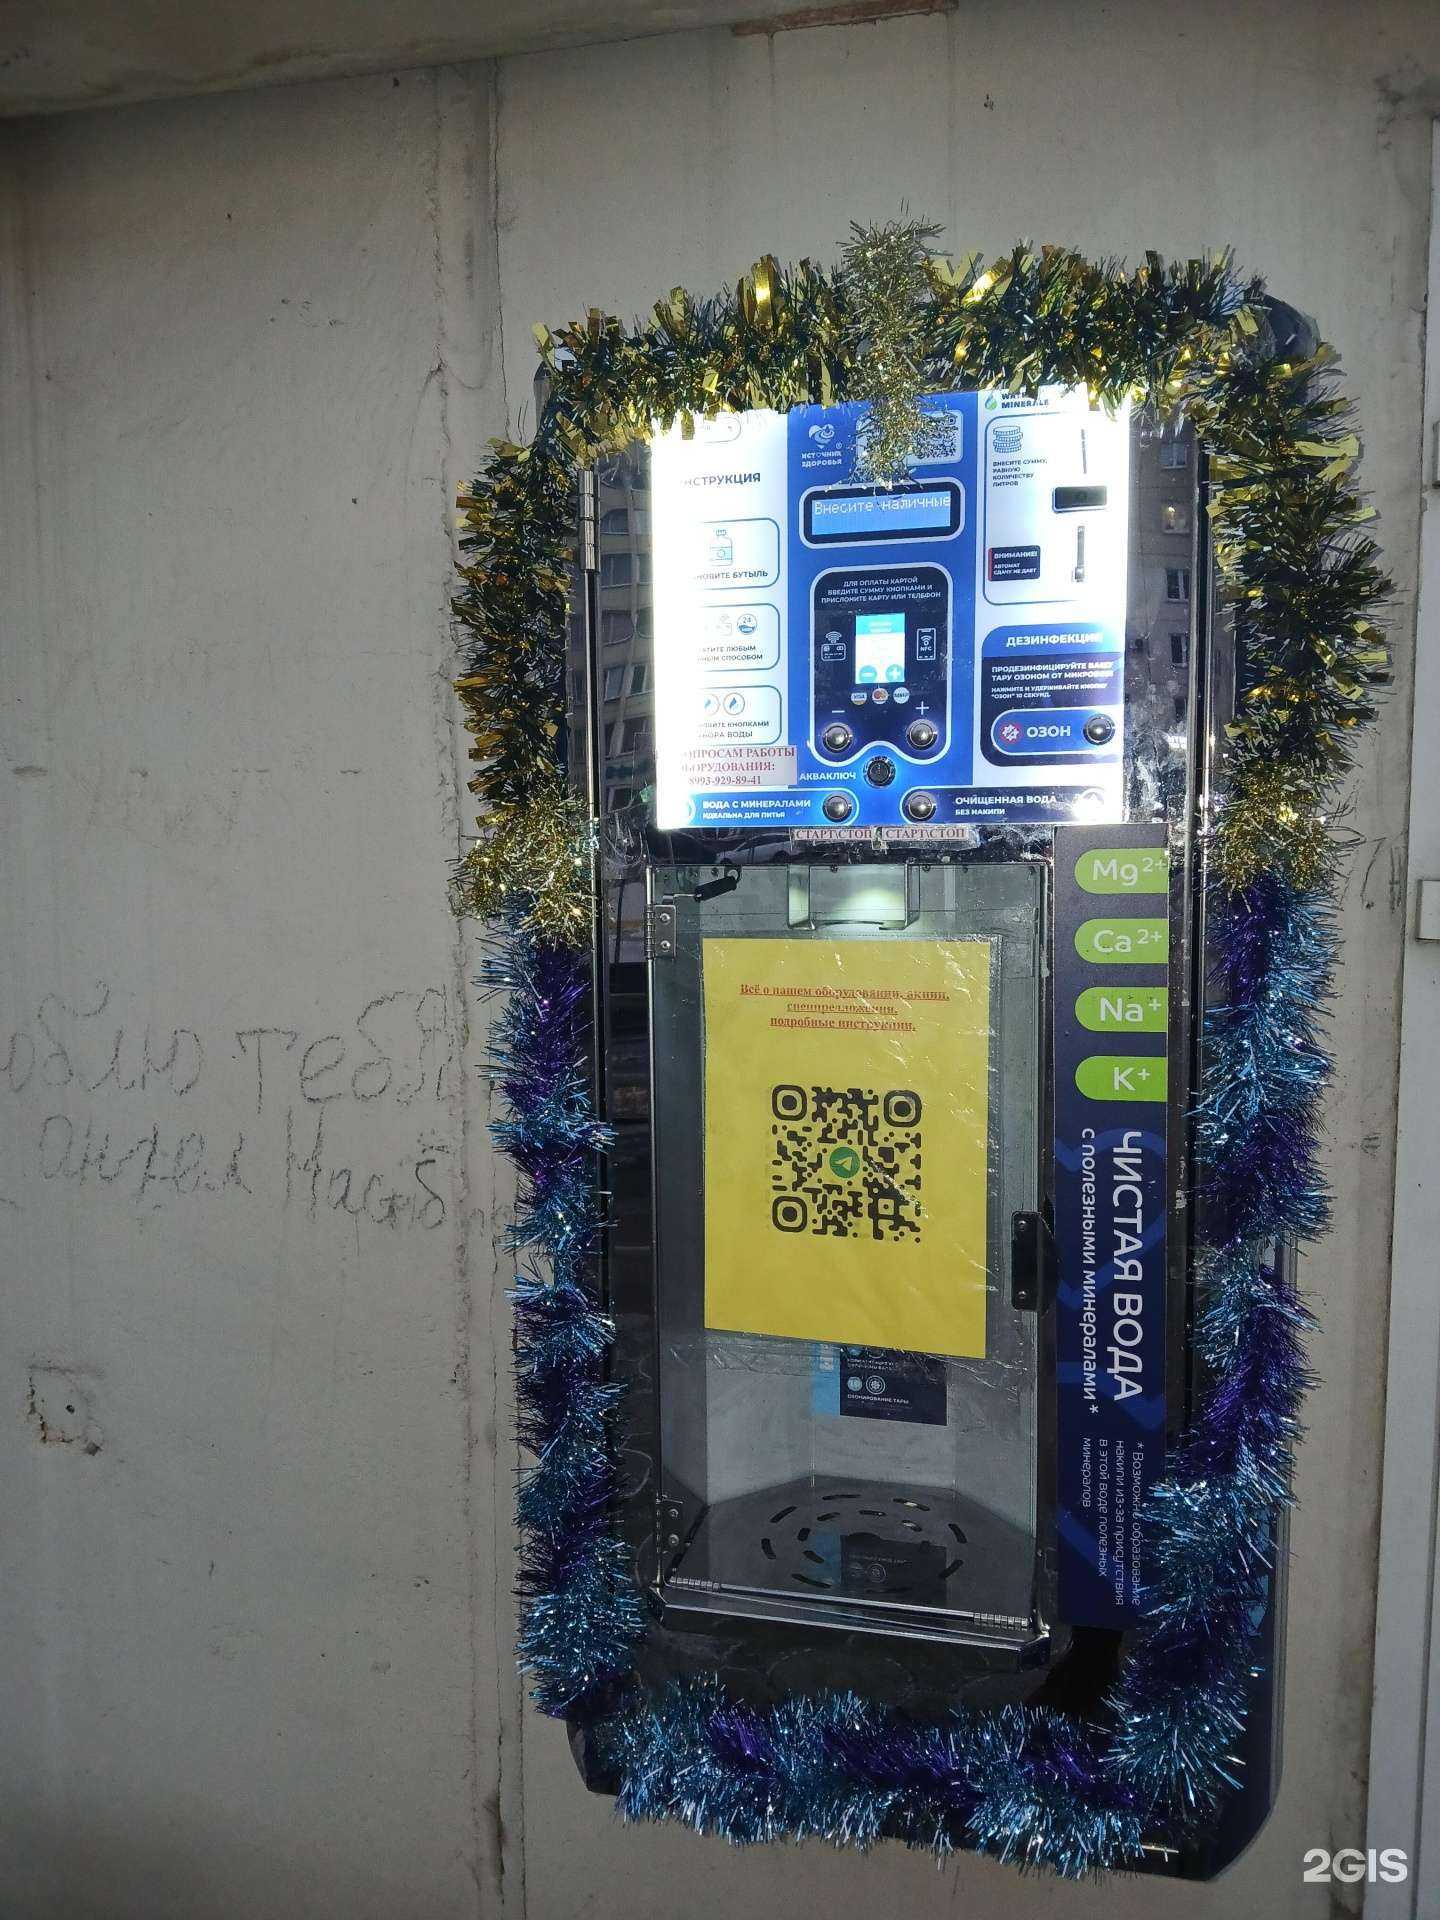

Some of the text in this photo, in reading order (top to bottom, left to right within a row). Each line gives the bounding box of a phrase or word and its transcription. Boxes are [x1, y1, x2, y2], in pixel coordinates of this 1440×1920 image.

[1001, 399, 1049, 409] MINERALE
[801, 451, 842, 459] ИСТОЧНИК
[801, 459, 842, 467] ЗДОРОВЬЯ
[680, 472, 761, 485] НСТРУКЦИЯ
[814, 495, 951, 515] Внесите наличные
[732, 570, 769, 579] БУТЫЛЬ
[859, 578, 889, 587] ОПЛАТЫ
[890, 576, 918, 585] КАРТОЙ
[827, 588, 859, 596] ВВЕДИТЕ
[860, 587, 885, 595] СУММУ
[886, 585, 926, 593] КНОПКАМИ
[821, 595, 867, 604] ПРИСЛОНИТЕ
[908, 591, 941, 599] ТЕЛЕФОН
[992, 662, 1087, 673] ПРОДЕЗИНФИЦИРУЙТЕ
[1031, 683, 1079, 691] УДЕРЖИВАЙТЕ
[727, 720, 770, 728] КНОПКАМИ
[1026, 725, 1071, 738] ОЗОН
[746, 747, 795, 757] РАБОТЫ
[800, 771, 856, 781] АКВАКЛЮЧ
[703, 800, 730, 809] ВОДА
[741, 800, 811, 808] МИНЕРАЛАМИ
[955, 794, 1057, 806] ОЧИЩЕННАЯ ВОДА
[955, 808, 970, 816] БЕЗ
[740, 984, 760, 995] Всё
[772, 987, 811, 996] нашем
[770, 1017, 834, 1031] подробные
[1082, 1128, 1095, 1138] с
[1082, 1144, 1096, 1265] полезными
[1107, 1131, 1143, 1401] ЧИСТАЯ ВОДА
[1099, 1449, 1110, 1479] этой
[1082, 1437, 1092, 1508] минералов
[1099, 1482, 1108, 1517] воде
[1113, 1440, 1124, 1606] накипи из-за присутствия
[1099, 1519, 1108, 1577] полезных
